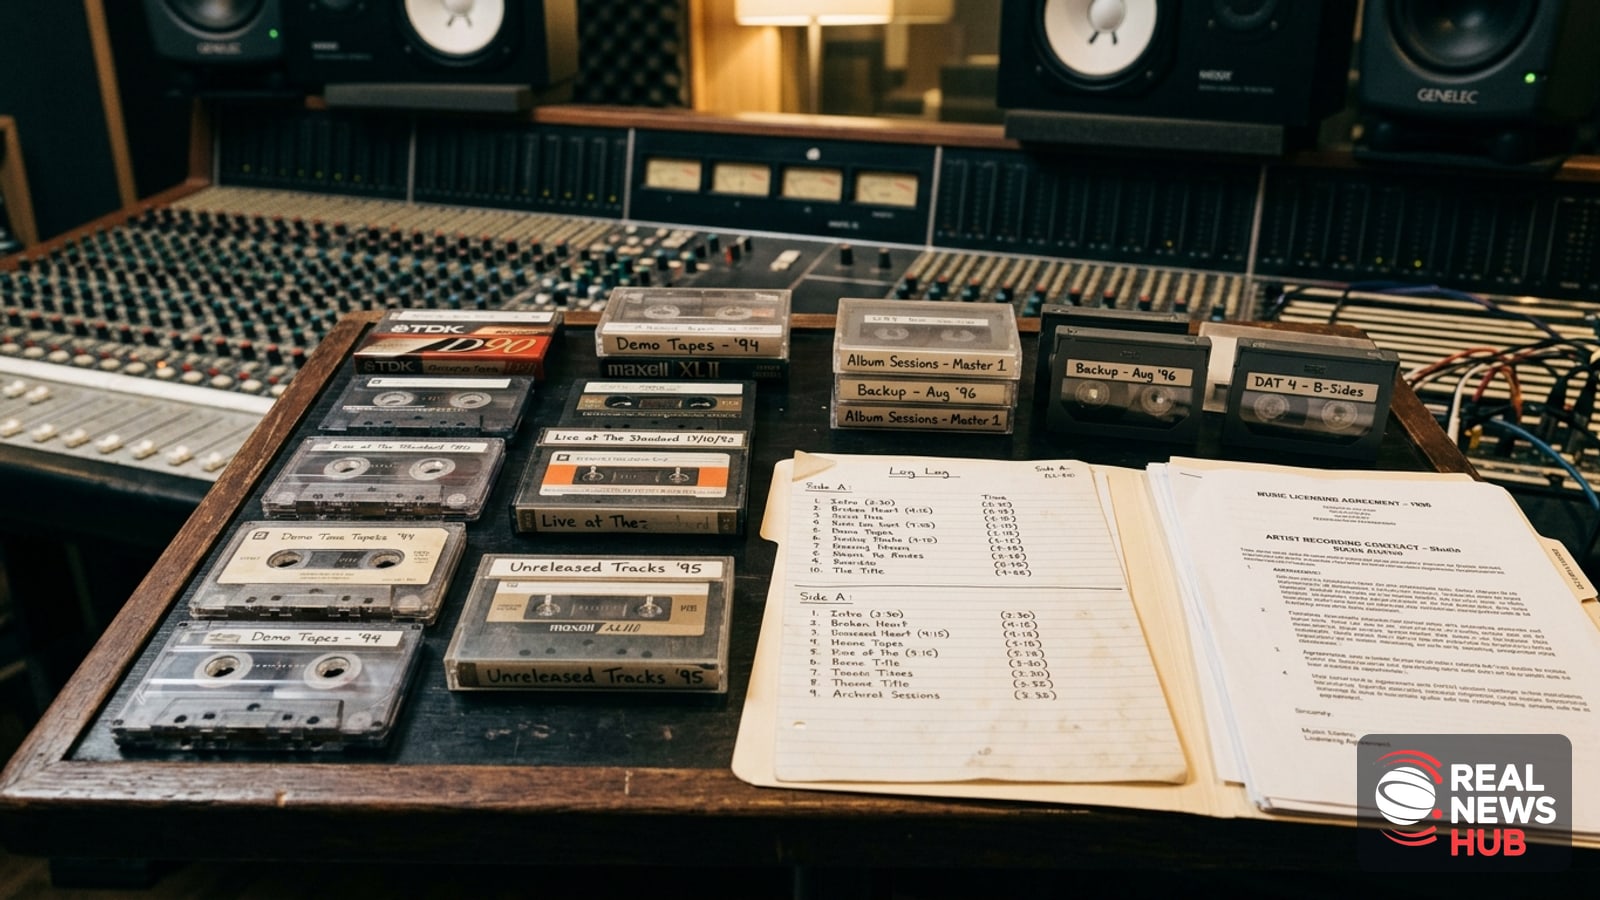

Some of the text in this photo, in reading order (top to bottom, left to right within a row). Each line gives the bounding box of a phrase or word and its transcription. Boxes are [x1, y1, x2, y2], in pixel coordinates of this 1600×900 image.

[1417, 88, 1479, 104] GENELEC
[411, 324, 465, 334] TDK
[616, 337, 660, 351] Demo
[667, 338, 714, 355] Tapes
[734, 338, 760, 353] '94
[375, 361, 416, 373] TDK
[608, 362, 669, 377] maxell
[847, 354, 885, 368] Album
[890, 355, 939, 370] Sessions
[952, 358, 993, 371] Master
[997, 359, 1007, 372] 1
[1076, 362, 1119, 379] Backup
[1132, 366, 1154, 383] Aug
[1157, 369, 1177, 382] '96
[858, 384, 906, 400] Backup
[926, 386, 950, 401] Aug
[955, 386, 977, 399] '96
[1254, 376, 1285, 390] DAT
[1287, 379, 1297, 391] 4
[1313, 382, 1365, 398] B-Sides
[845, 410, 884, 423] Album
[888, 411, 938, 425] Sessions
[951, 414, 989, 426] Master
[992, 414, 1002, 426] 1
[585, 434, 597, 442] at
[603, 434, 624, 442] The
[1257, 491, 1287, 499] MUSIC
[542, 514, 576, 528] Live
[585, 514, 603, 528] at
[1266, 534, 1300, 543] ARTIST
[1302, 536, 1362, 547] RECORDING
[510, 562, 702, 574] Unreleased Tracks '95
[800, 591, 828, 602] Side
[830, 609, 863, 619] Intro
[830, 619, 870, 628] Broken
[251, 631, 291, 642] Demo
[299, 632, 339, 643] Tapes
[487, 668, 704, 685] Unreleased Tracks '95
[891, 690, 941, 700] Sessions
